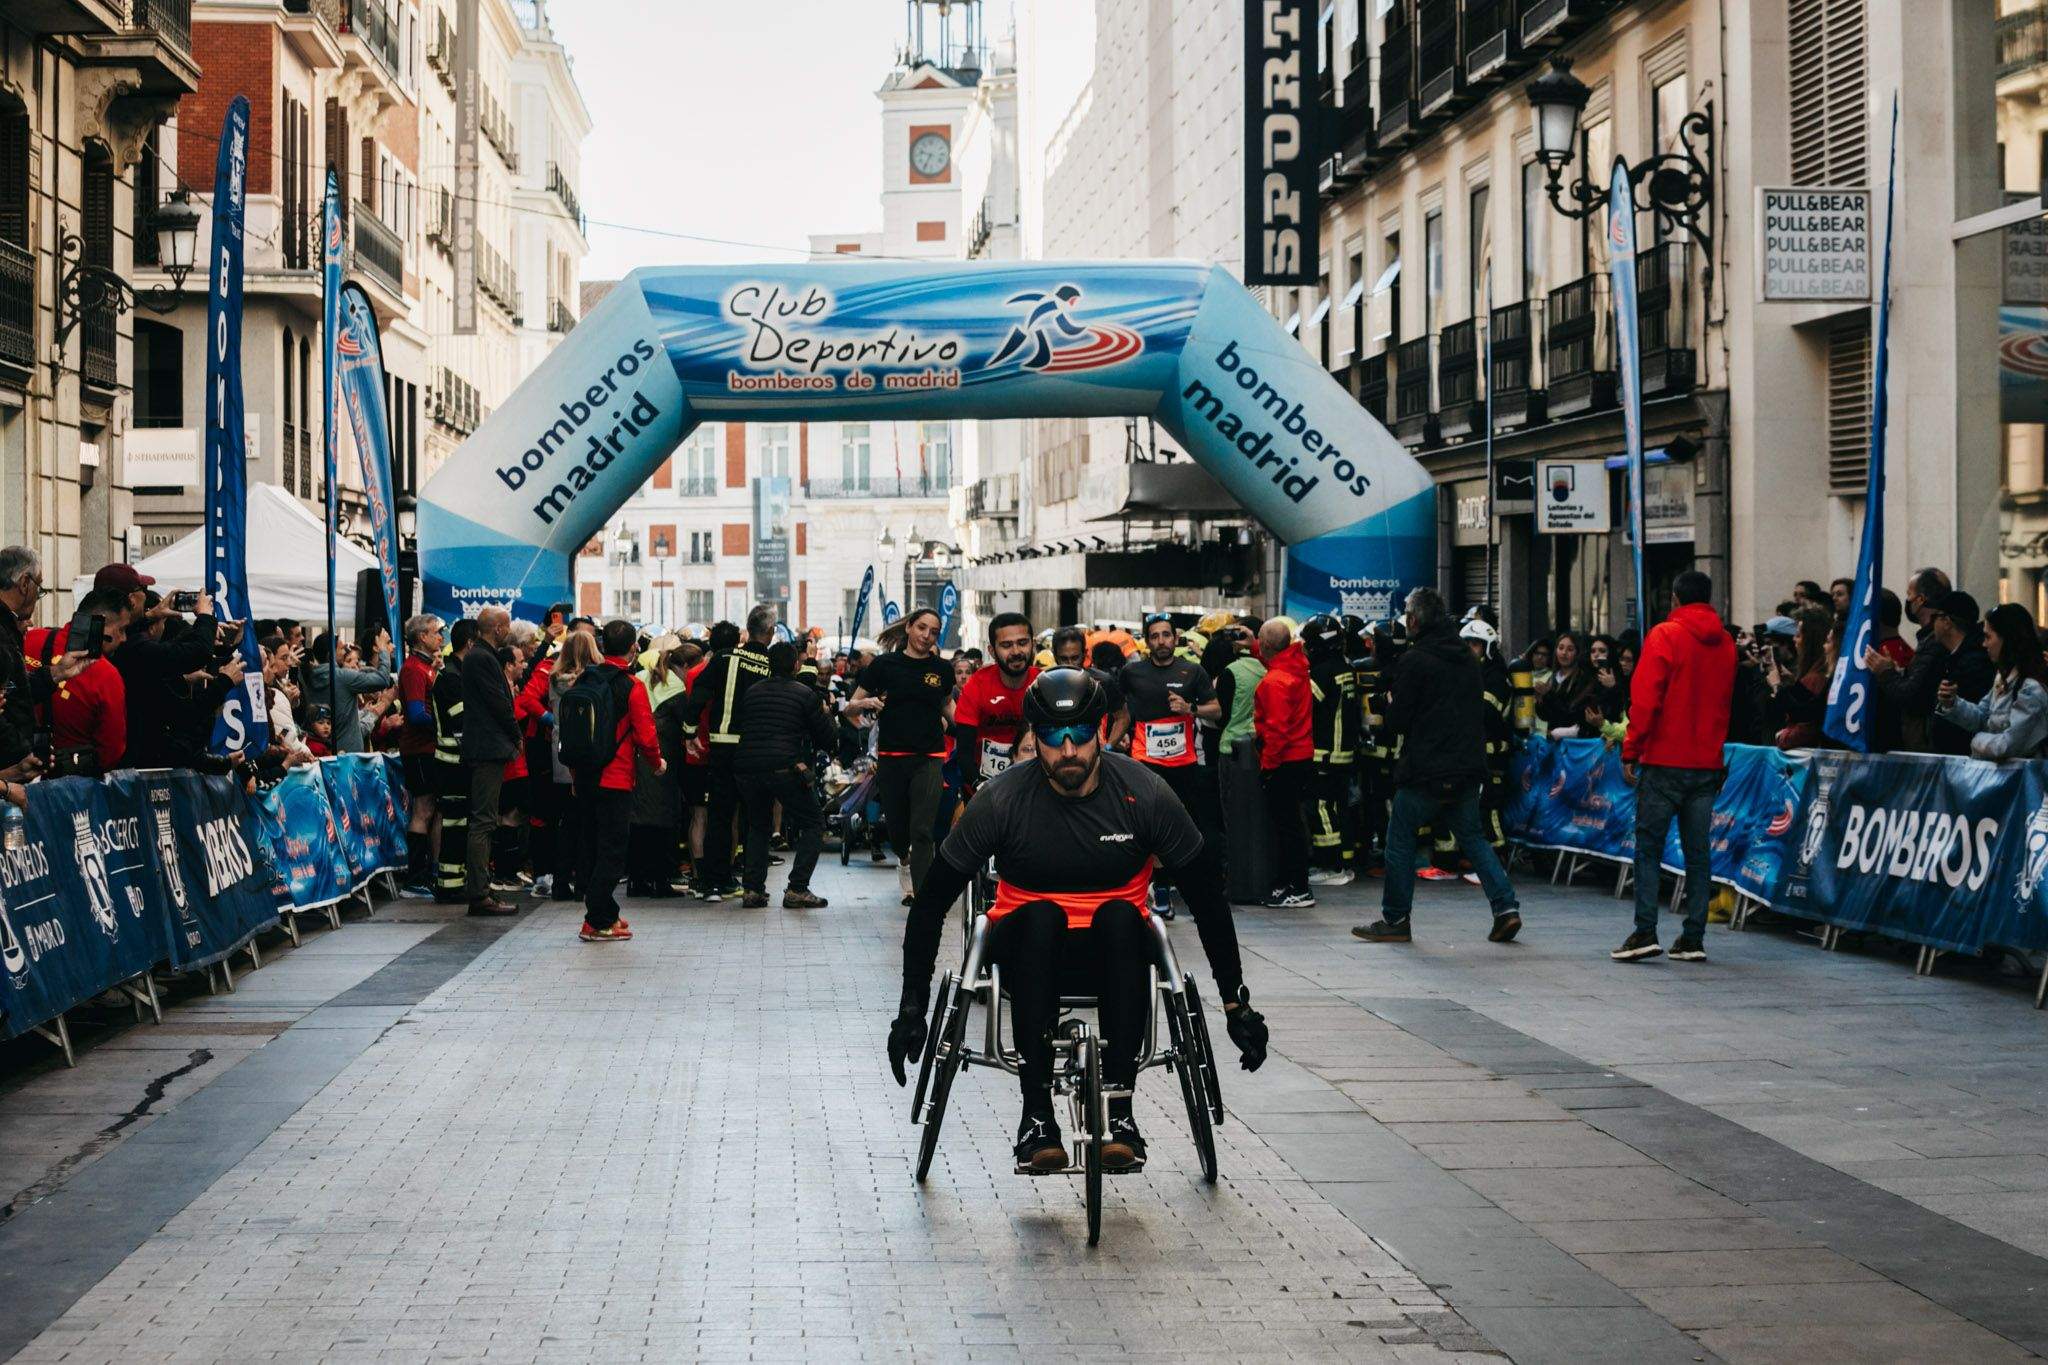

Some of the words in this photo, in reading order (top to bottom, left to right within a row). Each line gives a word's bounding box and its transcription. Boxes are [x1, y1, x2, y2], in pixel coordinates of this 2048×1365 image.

[1262, 0, 1301, 275] SPORT
[1766, 195, 1865, 211] PULL&BEAR
[1766, 216, 1865, 231] PULL&BEAR
[1767, 237, 1865, 252] PULL&BEAR
[1768, 258, 1866, 273] PULL&BEAR
[1769, 279, 1866, 294] PULL&BEAR
[730, 286, 826, 319] Club
[749, 317, 958, 373] Deportivo
[730, 371, 834, 390] bomberos
[847, 371, 873, 388] de
[886, 369, 959, 388] madrid
[495, 338, 655, 492] bomberos
[1215, 339, 1371, 498] bomberos
[1182, 378, 1320, 504] madrid
[532, 390, 661, 525] madrid
[1329, 576, 1400, 588] bomberos
[451, 585, 522, 599] bomberos
[740, 661, 770, 677] madrid
[1157, 738, 1177, 748] 456
[1837, 804, 2000, 892] BOMBEROS
